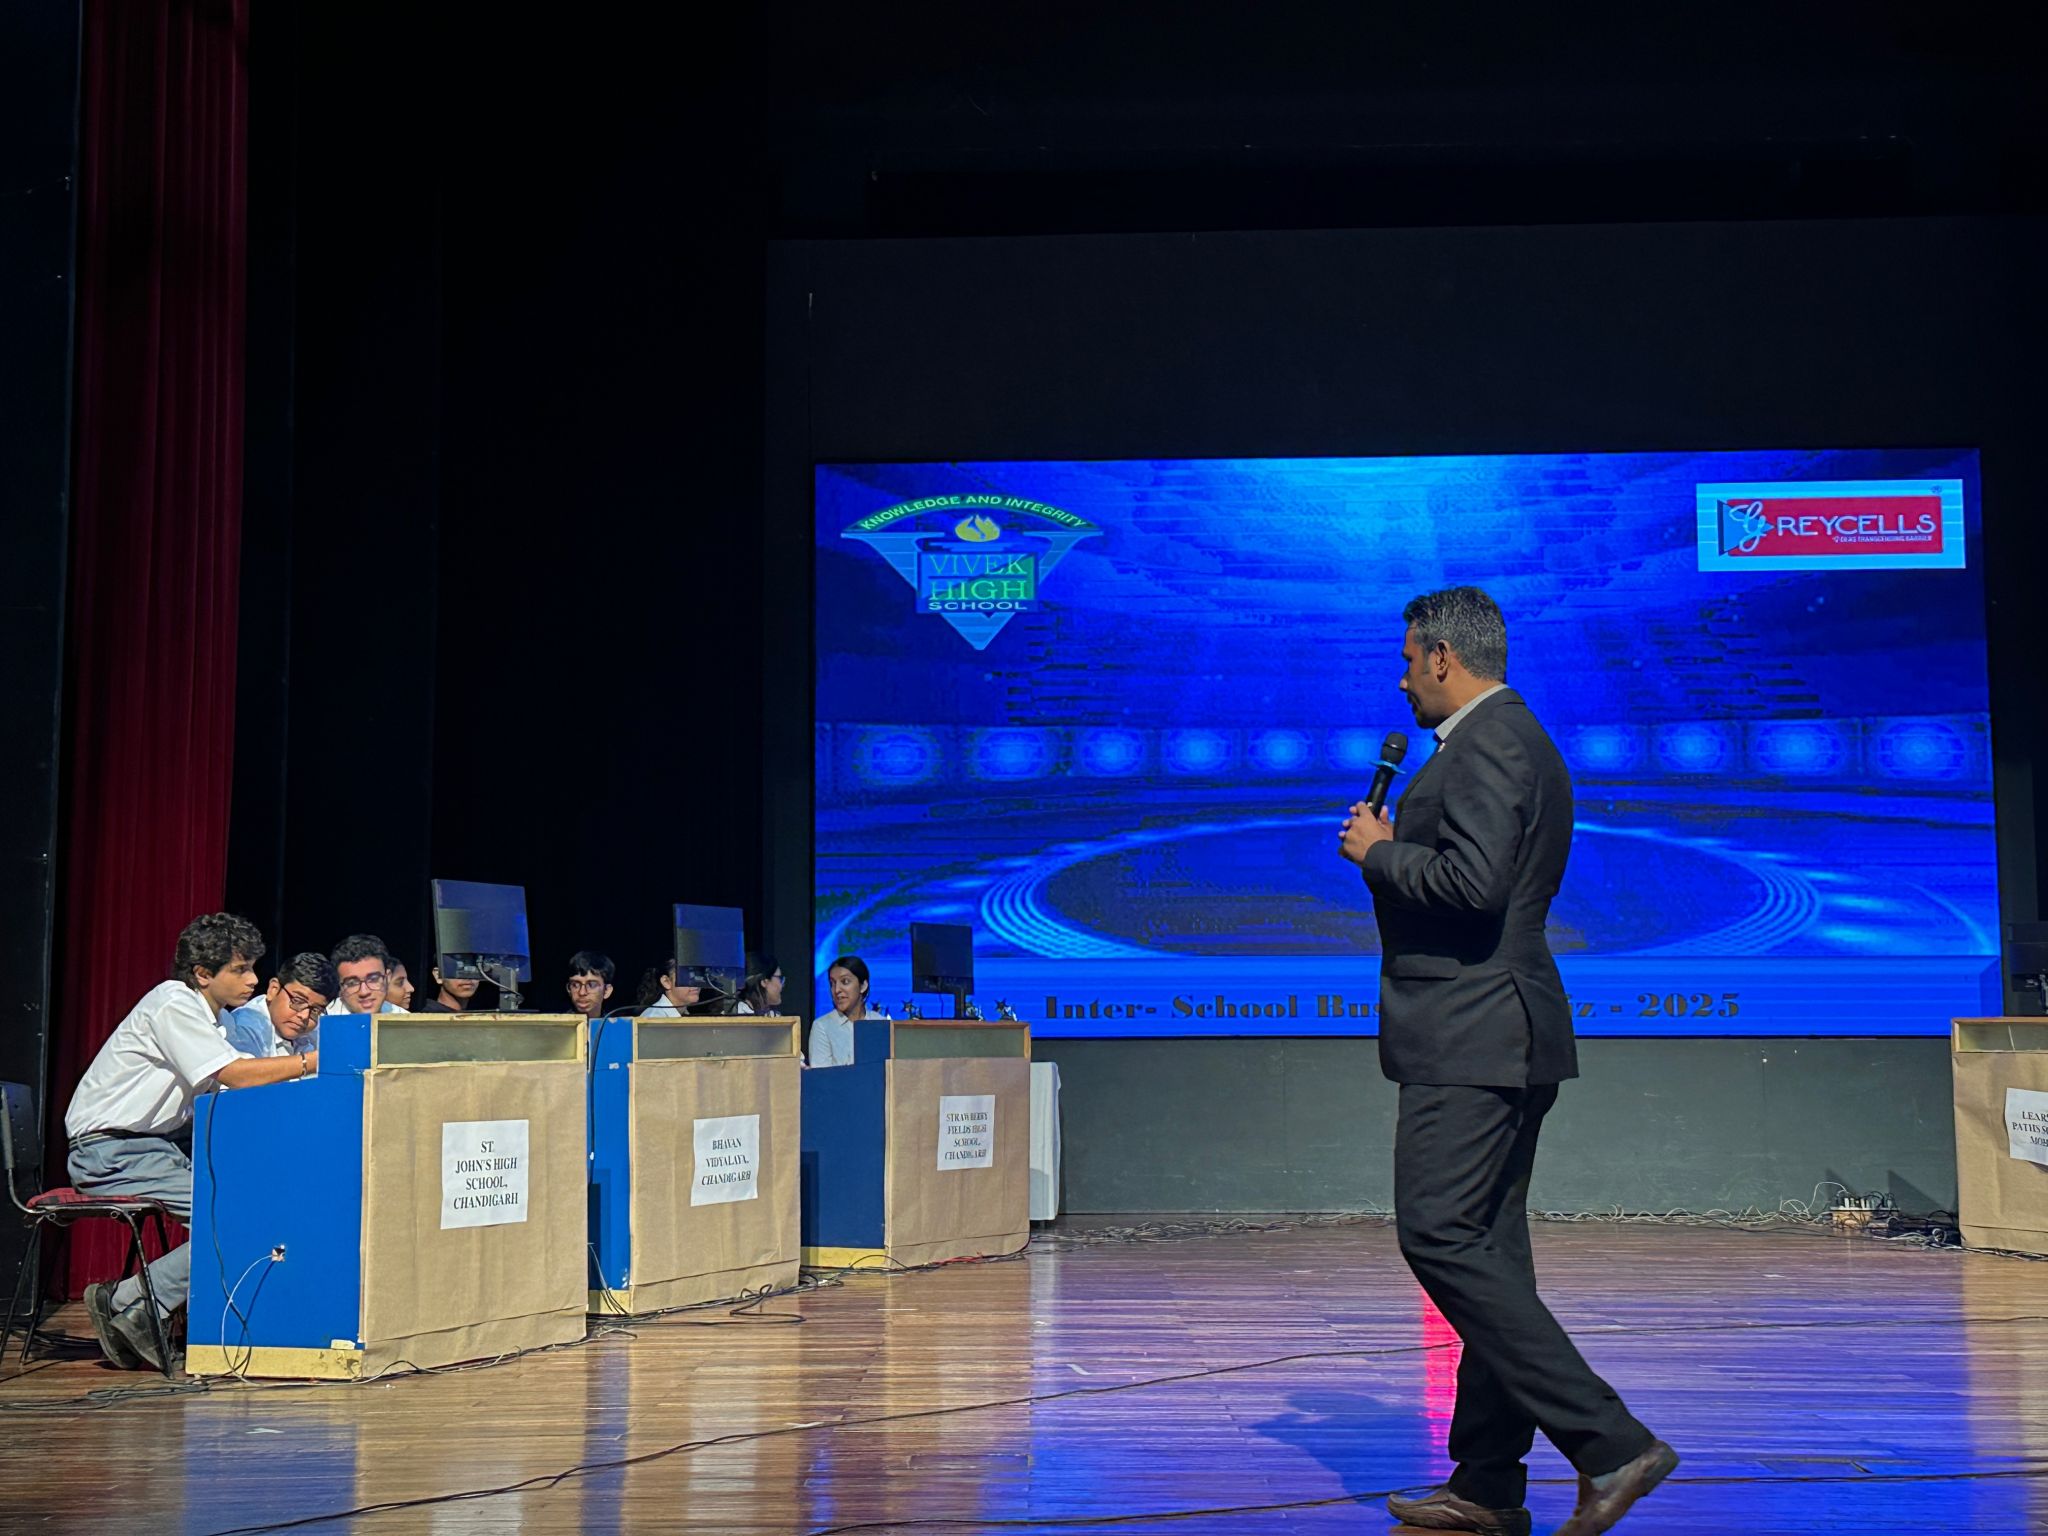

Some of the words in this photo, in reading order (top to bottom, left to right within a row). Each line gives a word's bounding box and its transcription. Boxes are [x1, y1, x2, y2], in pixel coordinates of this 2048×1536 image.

[861, 495, 961, 530] KNOWLEDGE
[965, 495, 1002, 505] AND
[1005, 497, 1088, 528] INTEGRITY
[929, 554, 1028, 575] VIVEK
[929, 580, 1028, 600] HIGH
[928, 601, 1028, 611] SCHOOL
[1044, 995, 1157, 1019] Inter-
[1171, 994, 1298, 1019] School
[1637, 993, 1741, 1018] 2025
[712, 1138, 742, 1150] BHAVAN
[455, 1158, 492, 1174] JOHN'S
[493, 1157, 518, 1170] HIGH
[465, 1175, 508, 1191] SCHOOL,
[701, 1170, 751, 1186] CHANDIGARH
[453, 1192, 519, 1210] CHANDIGARH
